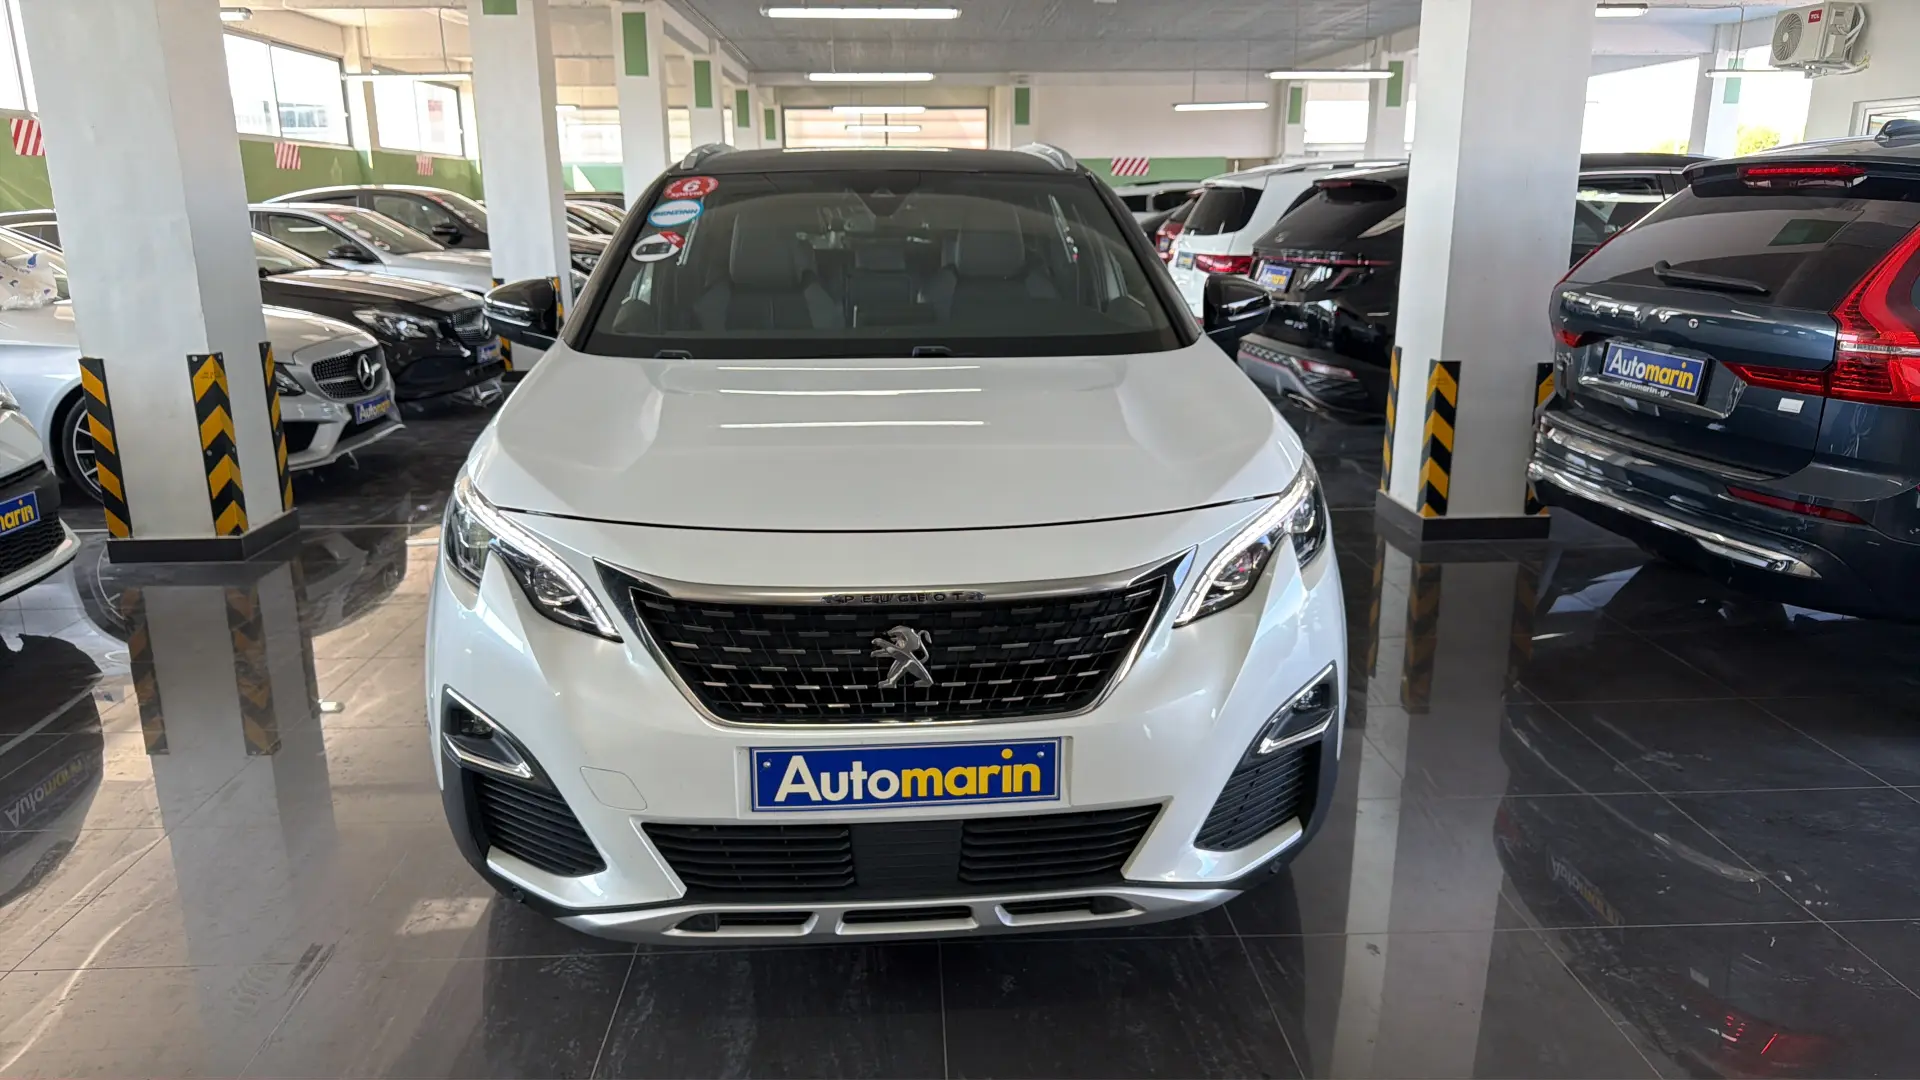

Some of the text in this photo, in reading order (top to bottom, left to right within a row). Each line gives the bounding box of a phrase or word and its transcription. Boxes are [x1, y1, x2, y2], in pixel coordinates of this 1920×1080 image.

[682, 180, 701, 193] 6
[1608, 348, 1694, 390] Automarin
[1619, 379, 1670, 397] Automarin.gr
[844, 591, 964, 604] PEUGEOT
[774, 747, 1041, 803] Automarin
